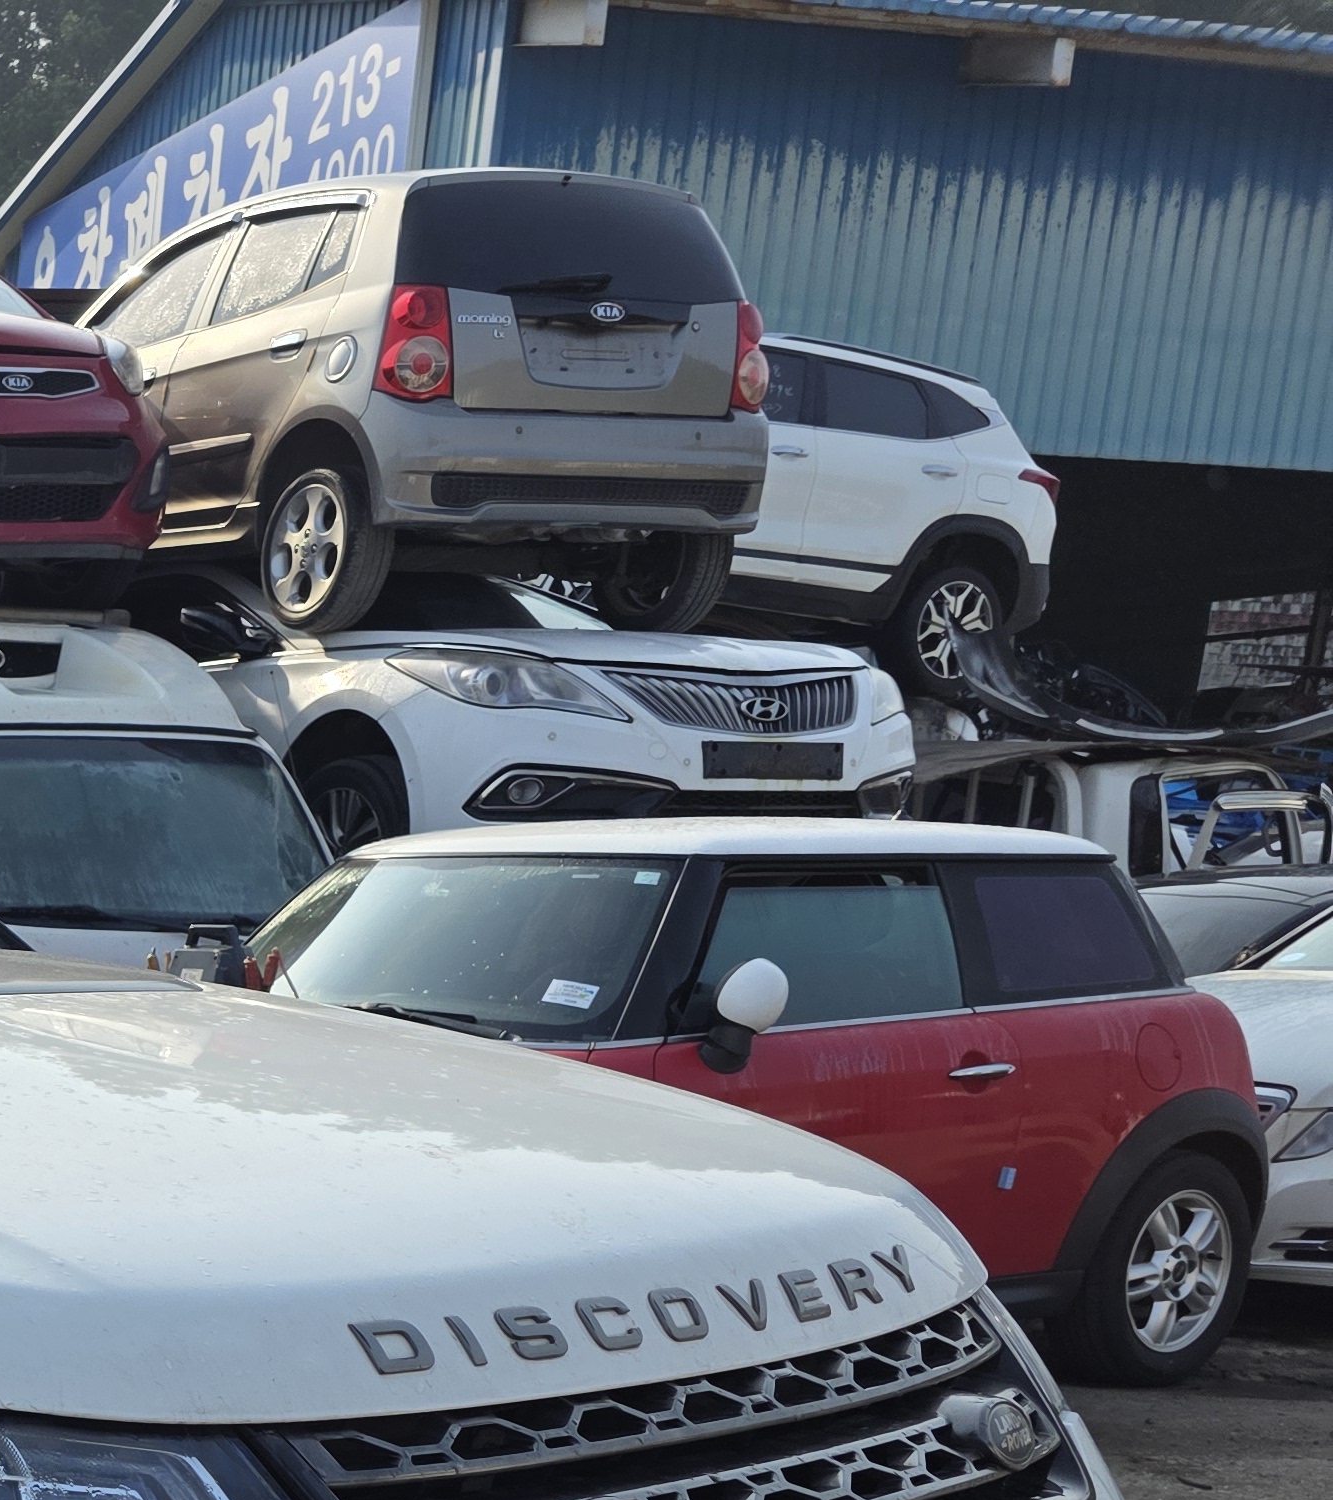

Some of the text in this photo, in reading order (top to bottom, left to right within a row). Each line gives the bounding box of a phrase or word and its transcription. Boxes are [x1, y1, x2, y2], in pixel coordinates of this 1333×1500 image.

[307, 43, 402, 145] 213-
[457, 313, 512, 327] morning
[595, 304, 621, 319] KIA
[6, 376, 31, 389] KIA
[347, 1244, 916, 1375] DISCOVERY
[994, 1412, 1021, 1435] LAND
[1007, 1427, 1032, 1453] ROVER
